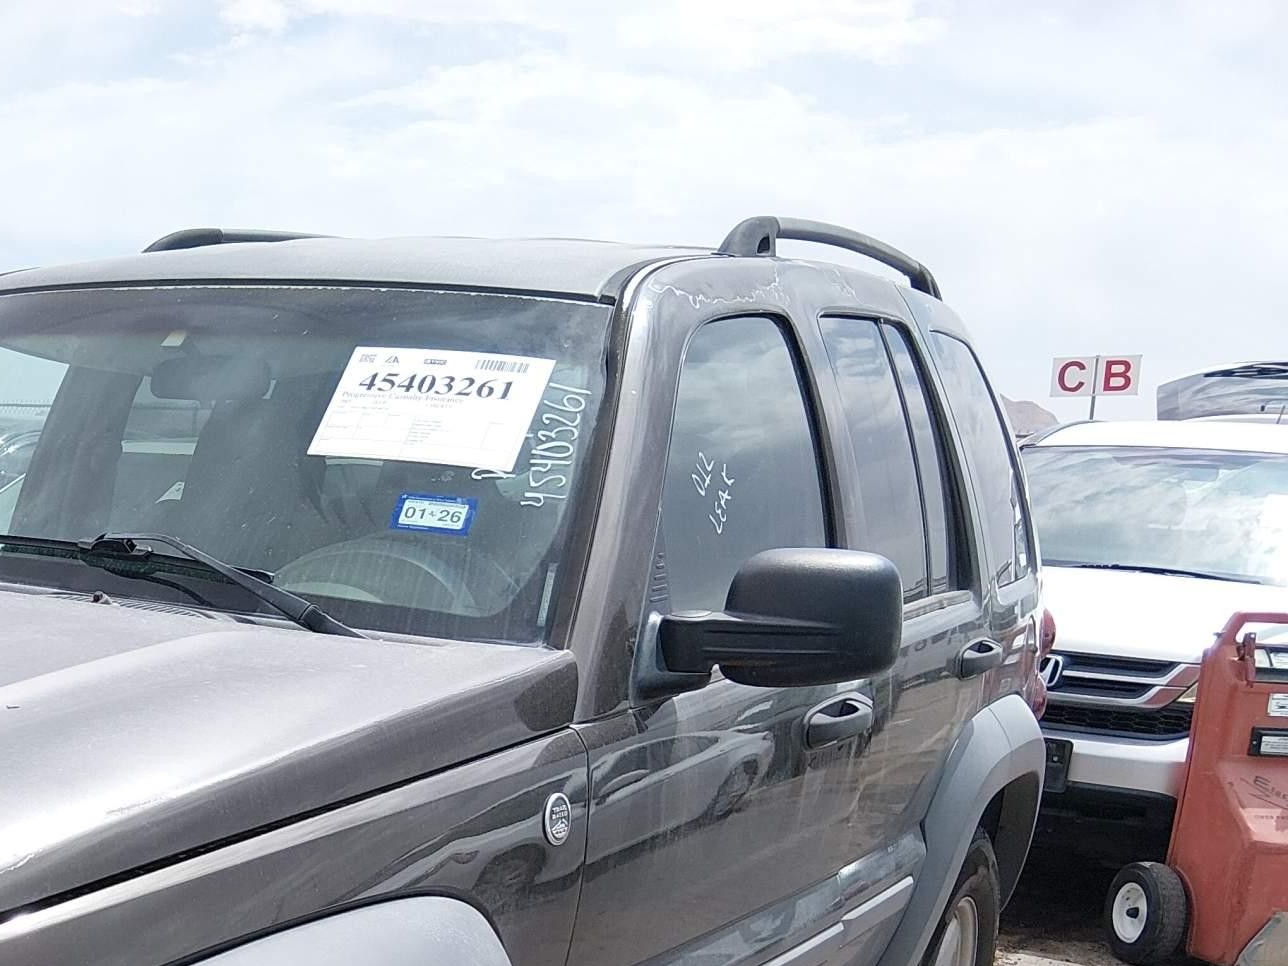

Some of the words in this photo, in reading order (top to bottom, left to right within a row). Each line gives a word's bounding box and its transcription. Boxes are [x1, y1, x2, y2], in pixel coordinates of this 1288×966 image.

[359, 372, 514, 401] 45403261
[1058, 361, 1086, 392] C
[1103, 360, 1131, 391] B
[520, 382, 592, 507] 45403261
[709, 463, 735, 535] LEAK
